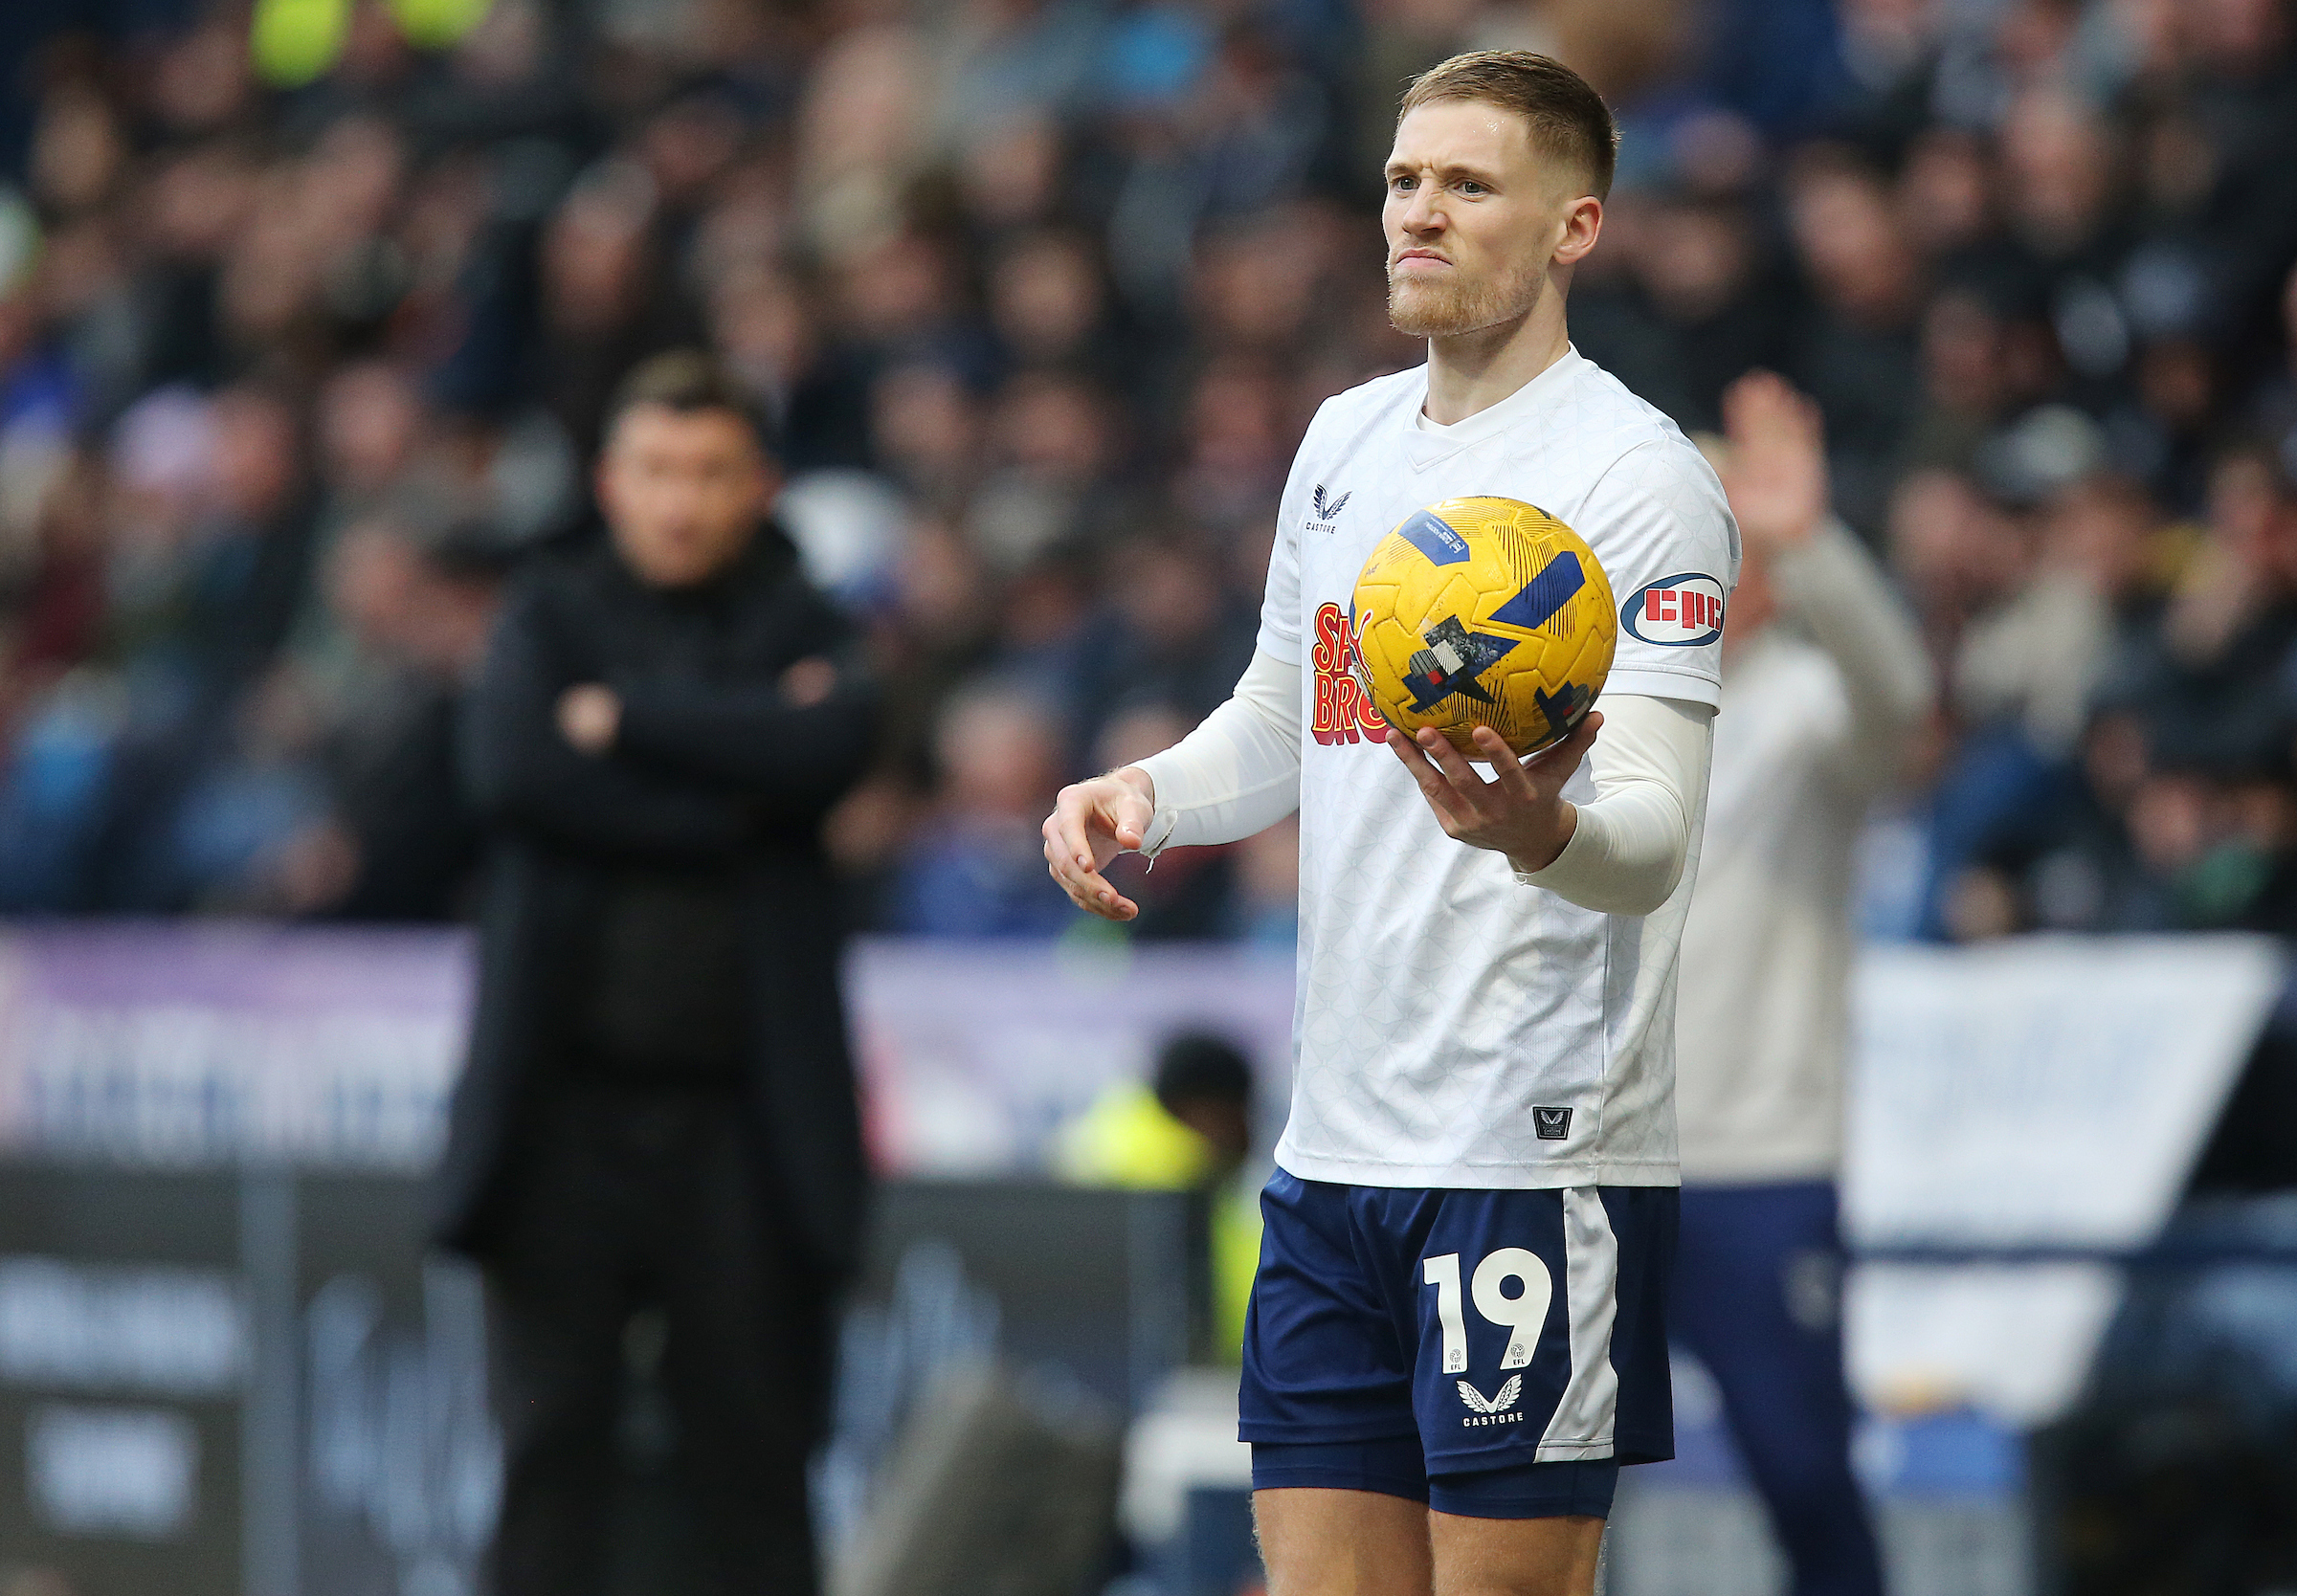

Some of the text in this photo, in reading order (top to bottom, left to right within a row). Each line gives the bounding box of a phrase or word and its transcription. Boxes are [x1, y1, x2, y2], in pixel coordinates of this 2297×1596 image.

[1305, 521, 1336, 534] CASTORE
[1423, 1247, 1552, 1374] 19
[1462, 1411, 1524, 1427] CASTORE
